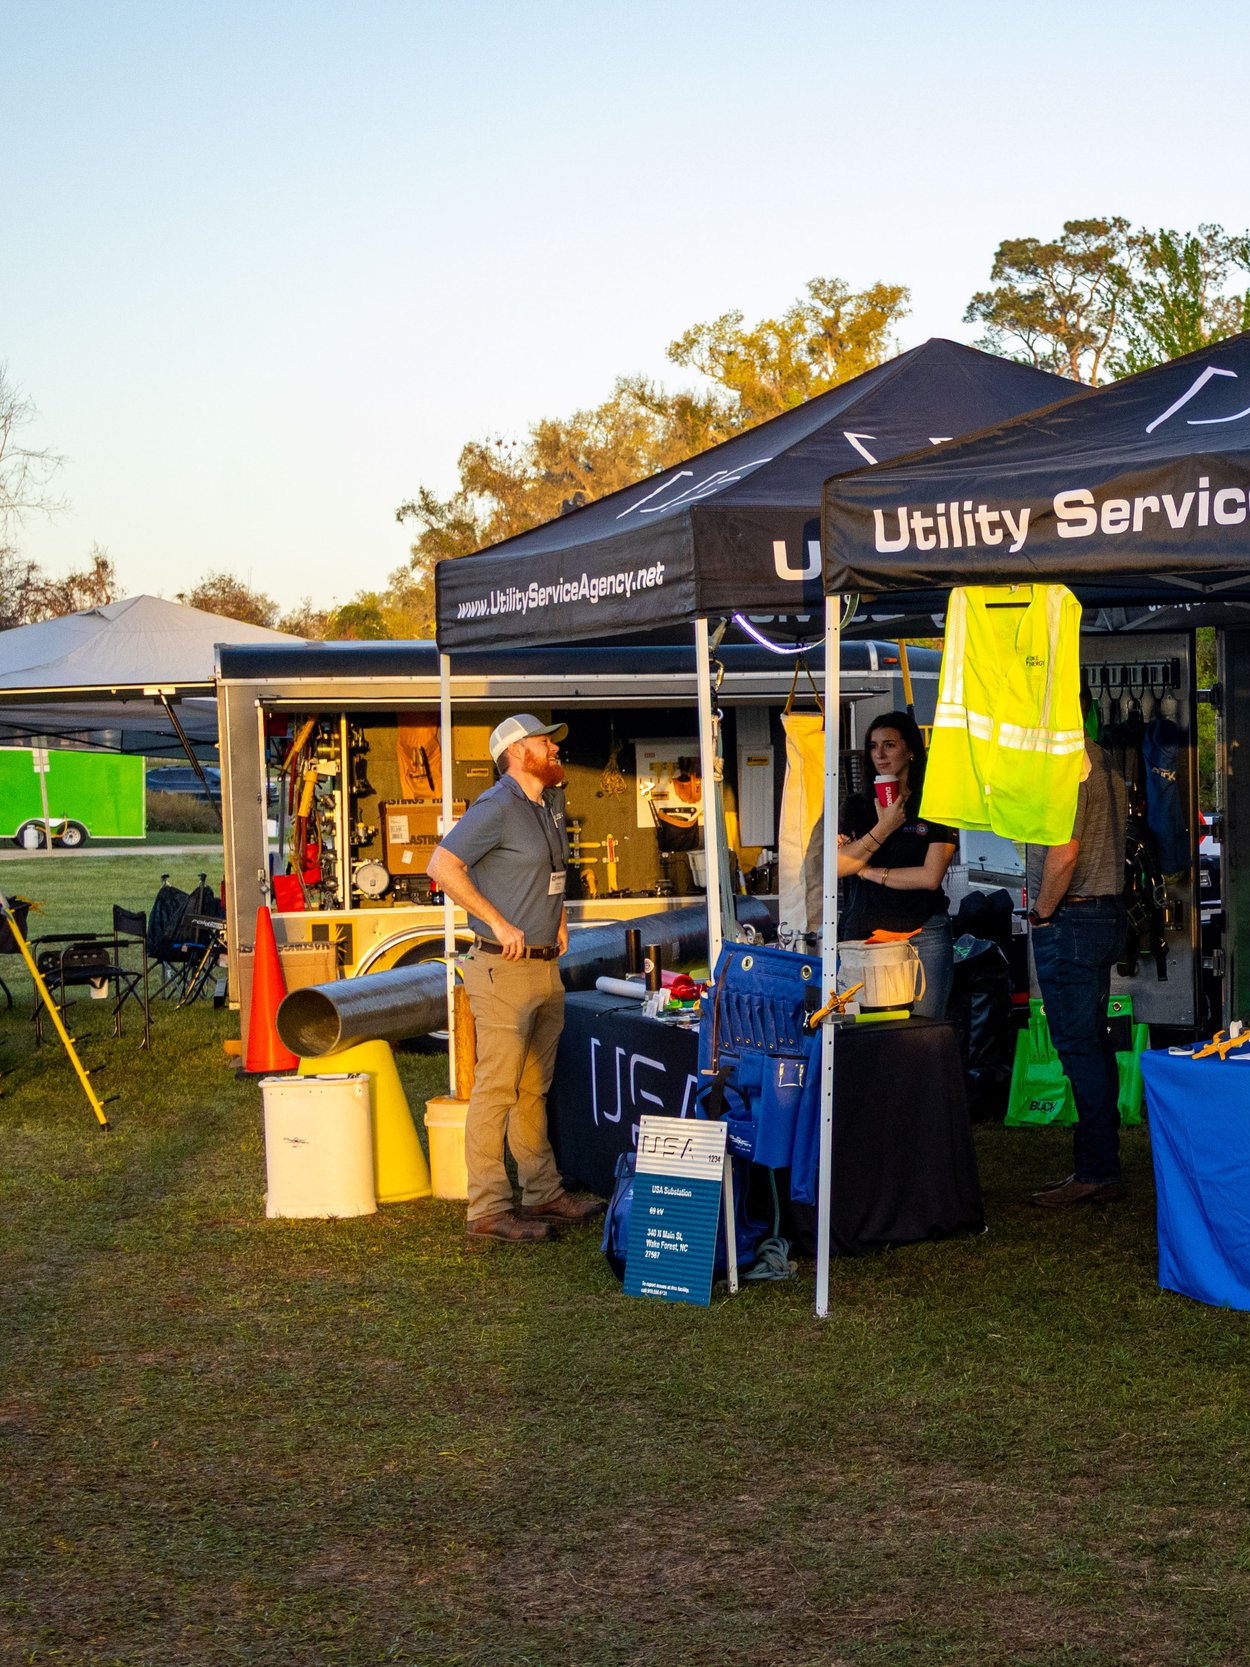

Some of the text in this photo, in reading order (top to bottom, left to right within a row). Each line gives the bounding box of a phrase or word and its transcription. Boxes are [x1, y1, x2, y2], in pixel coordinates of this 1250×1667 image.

[873, 500, 1030, 553] Utility
[457, 561, 665, 619] www.UtilityServiceAgency.net
[642, 1135, 694, 1160] USA
[708, 1154, 721, 1163] 1234
[651, 1185, 692, 1197] USA Substation
[662, 1229, 675, 1239] Main
[645, 1239, 660, 1249] Wake
[679, 1244, 689, 1252] NC
